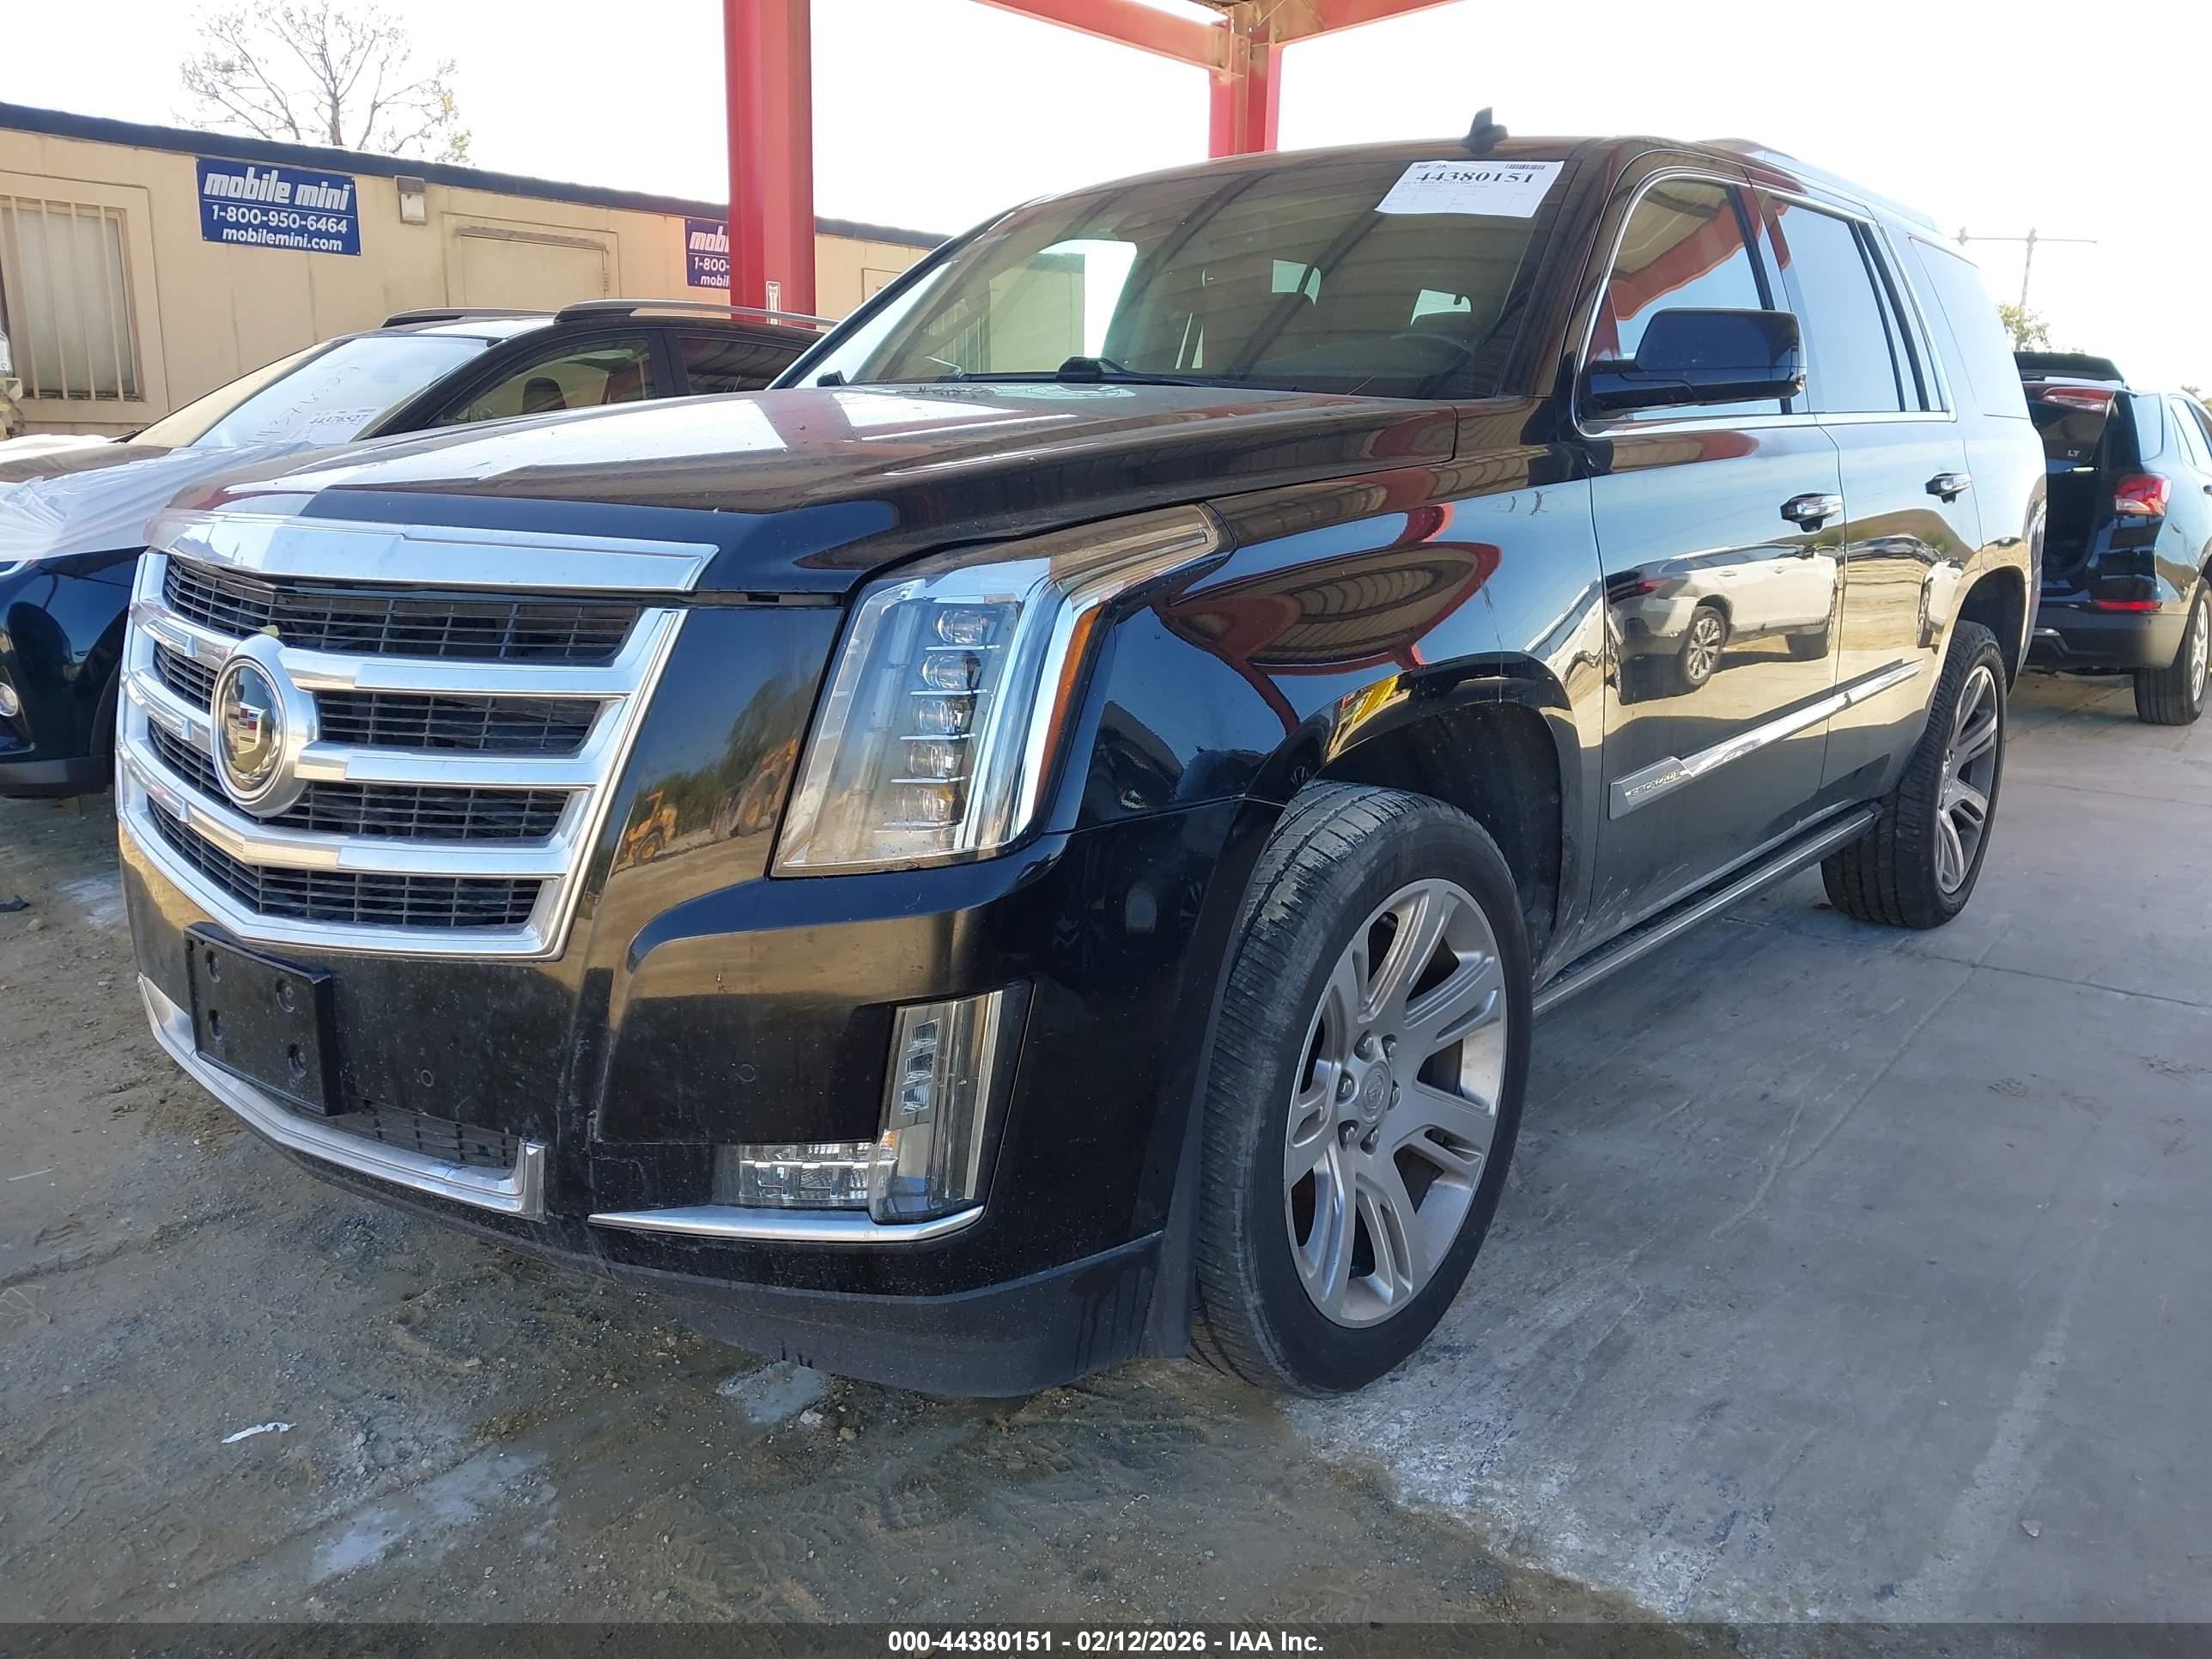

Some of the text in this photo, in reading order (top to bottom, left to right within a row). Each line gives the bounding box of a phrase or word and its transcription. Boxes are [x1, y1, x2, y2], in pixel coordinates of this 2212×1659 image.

[204, 167, 350, 210] mobile mini
[1416, 171, 1534, 183] 44380151
[212, 205, 347, 234] 1-800-950-6464
[222, 228, 343, 251] mobilemini.com
[689, 225, 729, 252] mobi
[694, 257, 730, 271] 1-800-
[700, 275, 730, 287] mobil
[1631, 769, 1681, 797] ESCALADE
